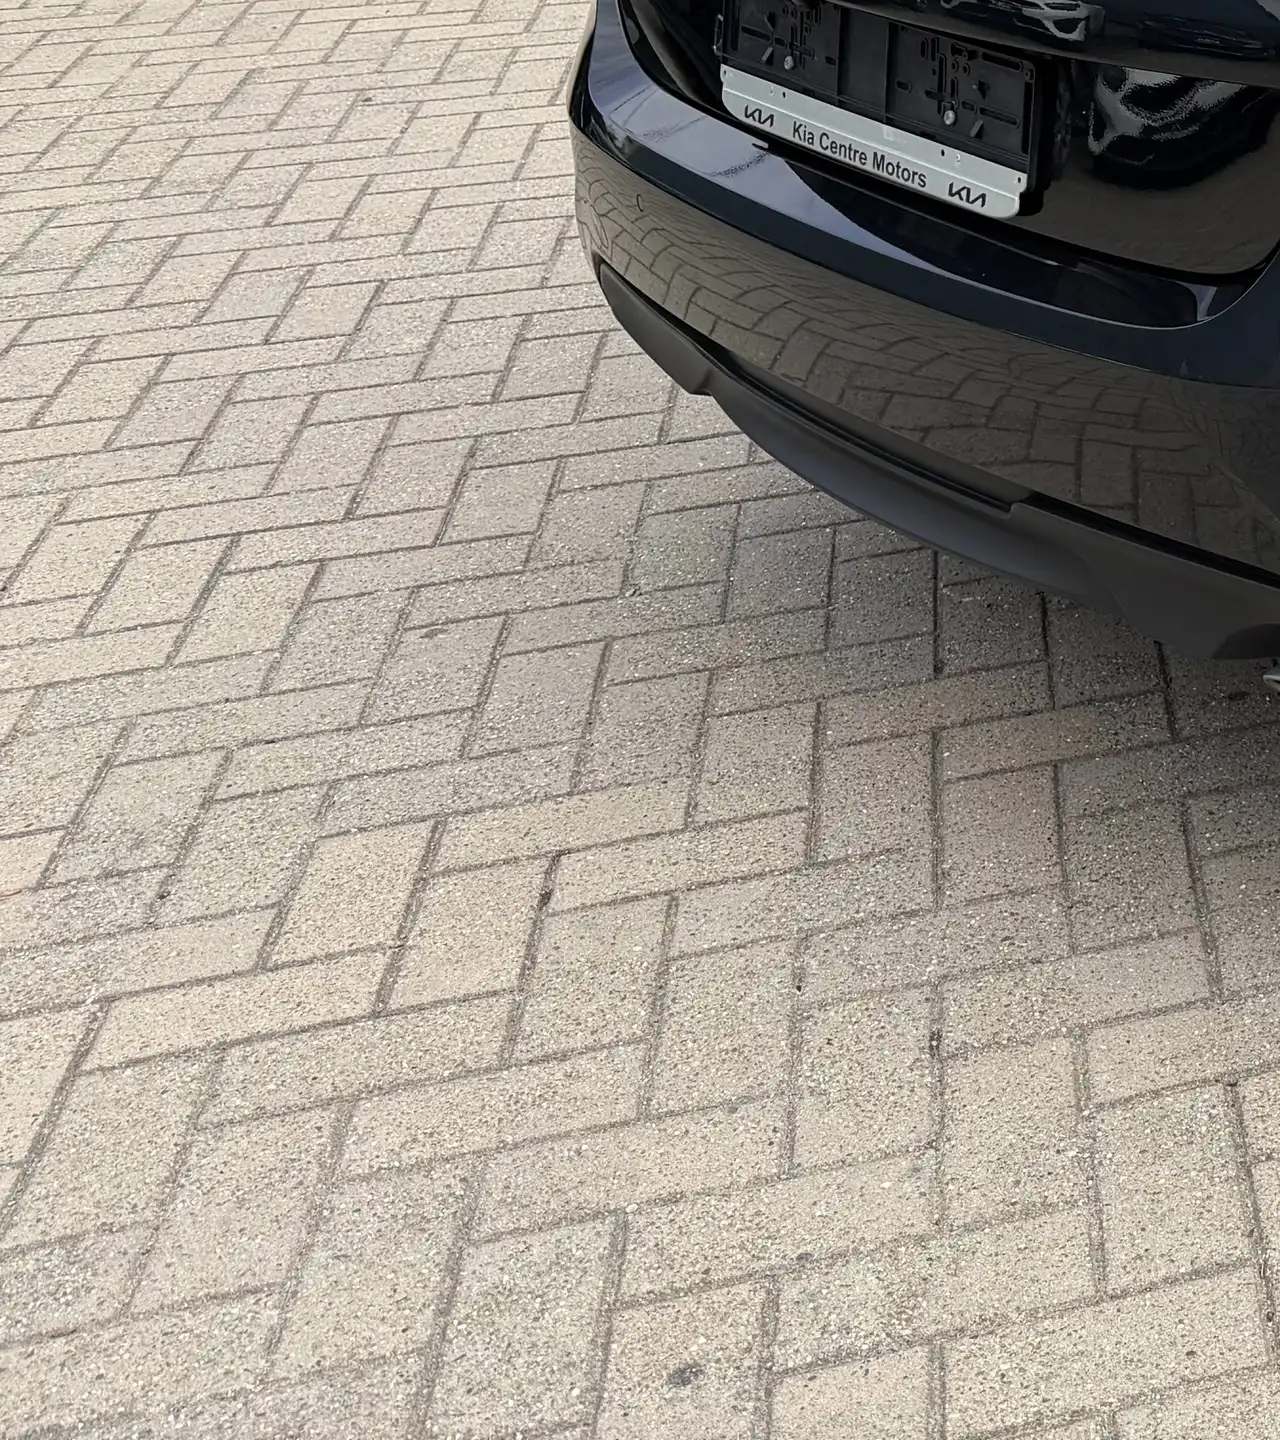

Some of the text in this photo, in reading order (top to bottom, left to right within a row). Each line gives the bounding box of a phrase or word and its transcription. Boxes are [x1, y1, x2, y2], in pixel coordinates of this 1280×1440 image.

[792, 121, 814, 146] Kia
[819, 133, 868, 166] Centre
[872, 151, 928, 189] Motors
